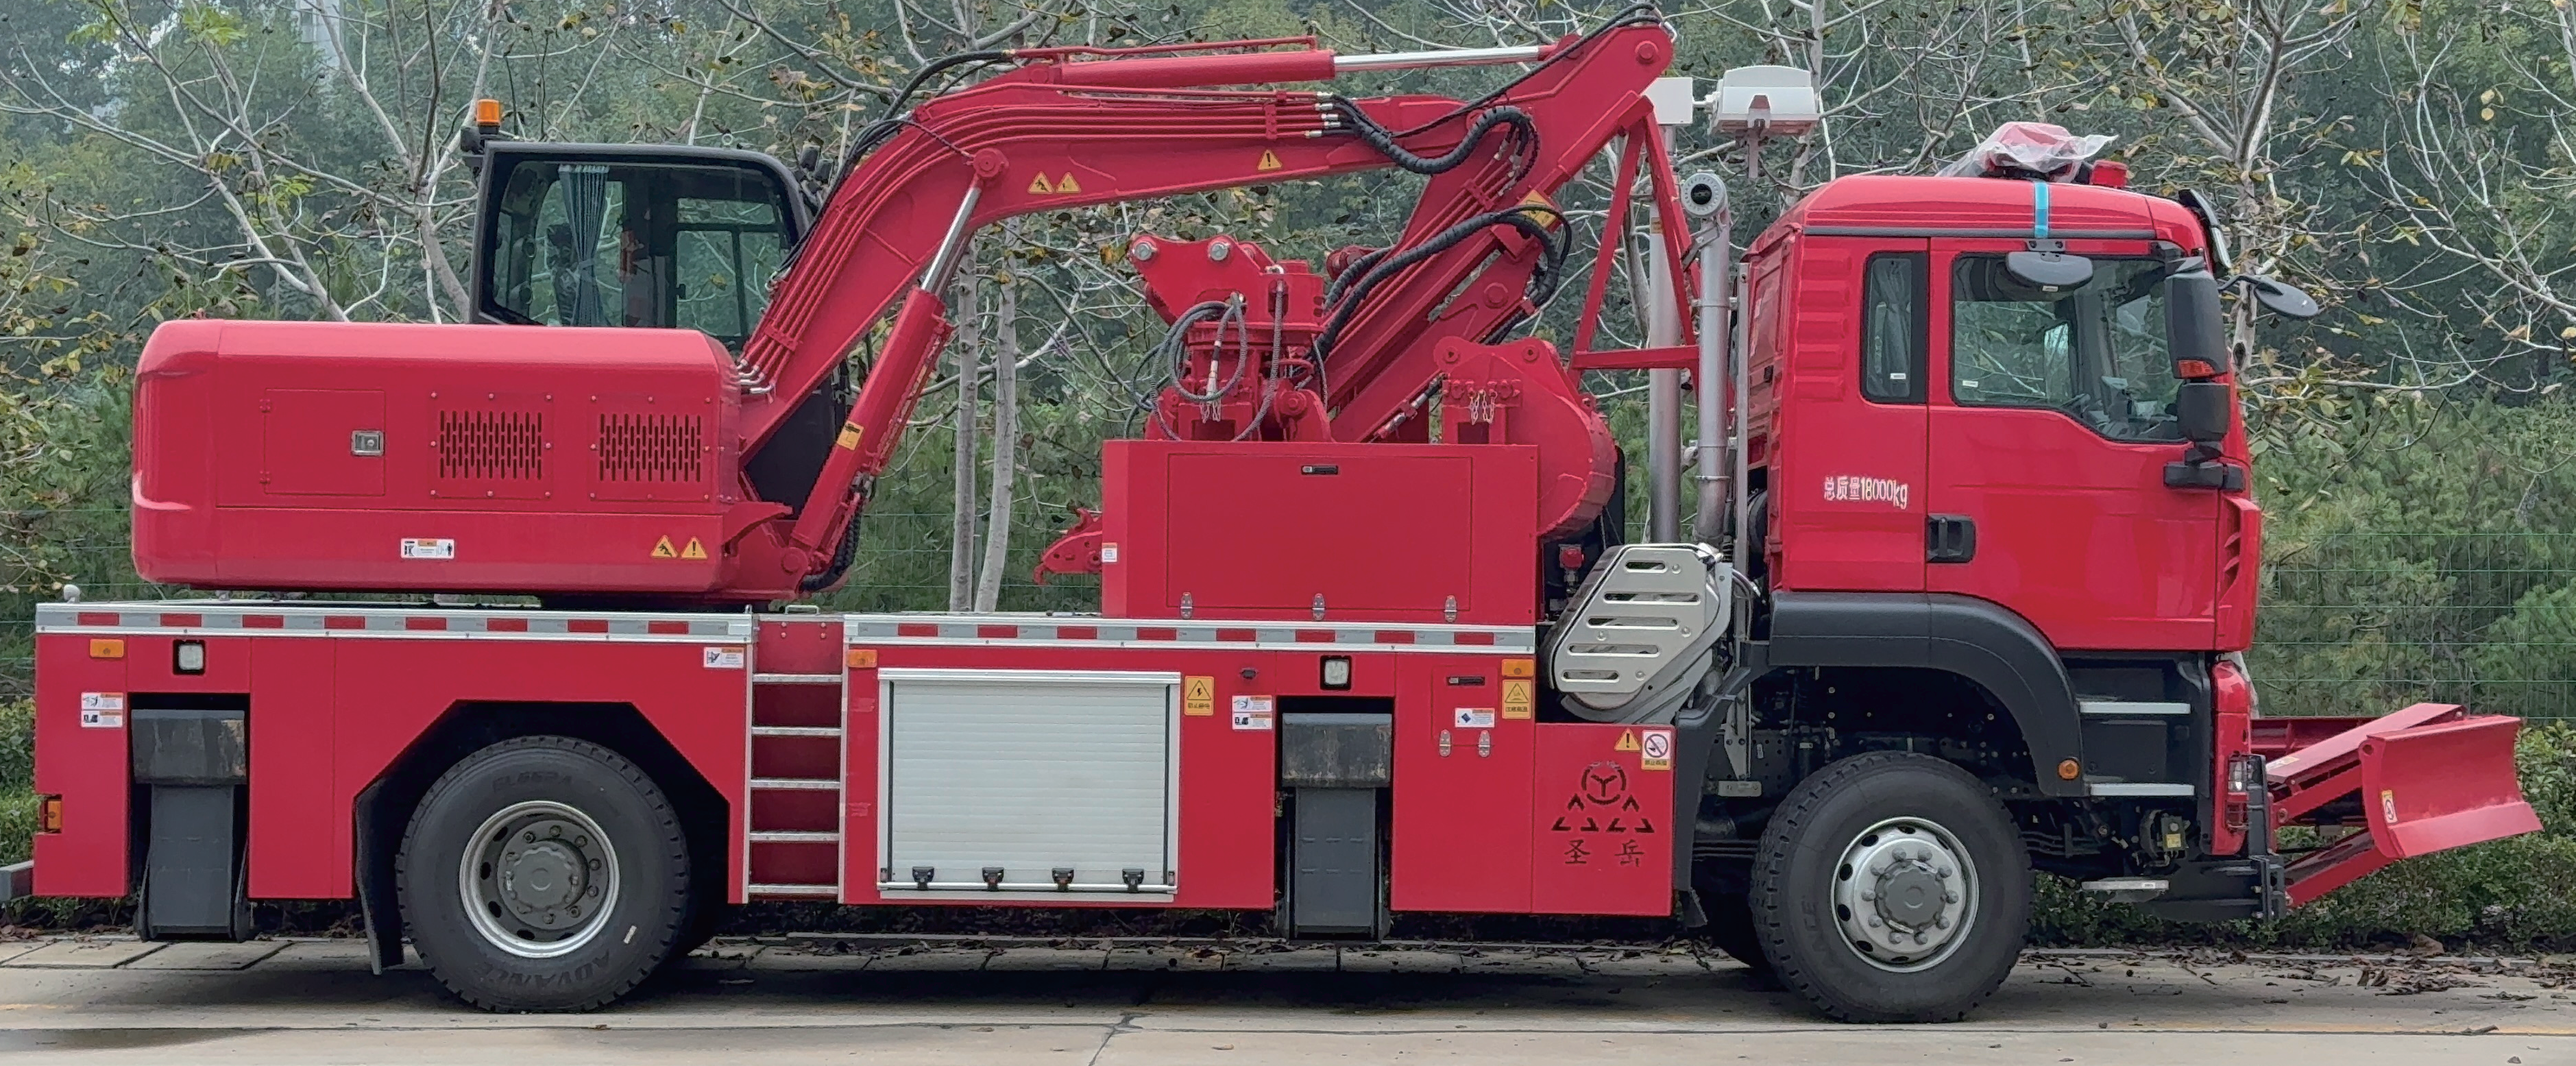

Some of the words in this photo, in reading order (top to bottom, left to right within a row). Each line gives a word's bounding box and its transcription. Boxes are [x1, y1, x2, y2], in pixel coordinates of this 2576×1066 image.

[1824, 475, 1908, 509] 总质量18000kg
[1564, 838, 1645, 867] 圣岳
